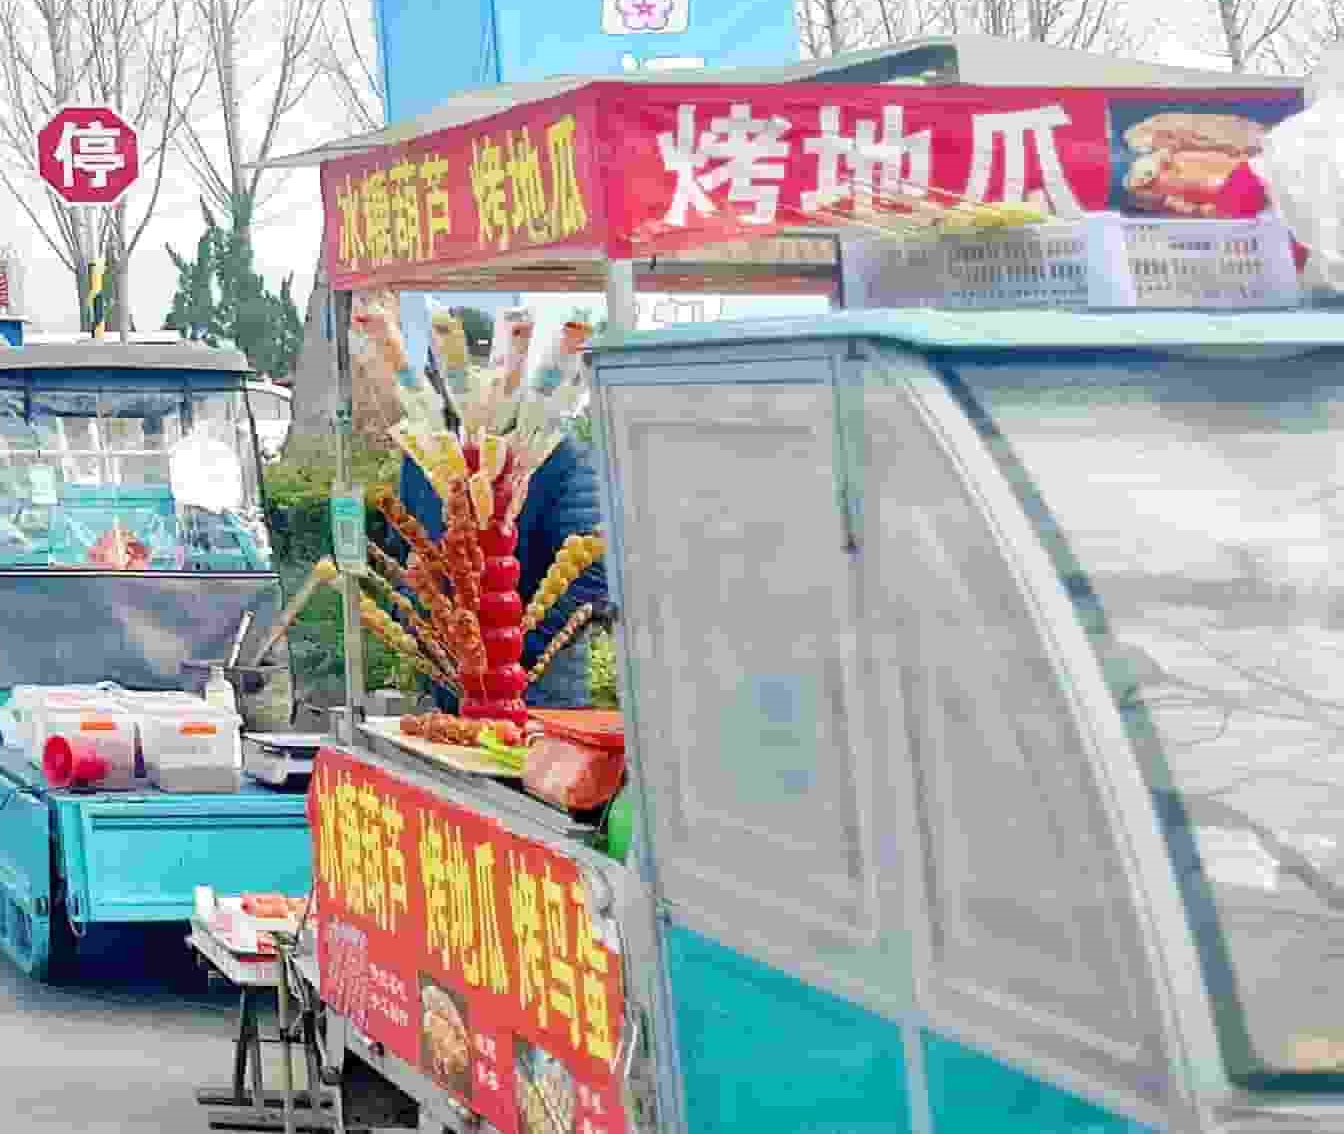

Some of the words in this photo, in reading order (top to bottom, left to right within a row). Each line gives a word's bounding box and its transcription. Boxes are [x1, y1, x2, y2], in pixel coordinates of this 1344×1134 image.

[54, 119, 126, 188] 停
[467, 114, 590, 250] 烤地瓜
[655, 102, 1084, 226] 烤地瓜
[416, 807, 510, 995] 烤地瓜
